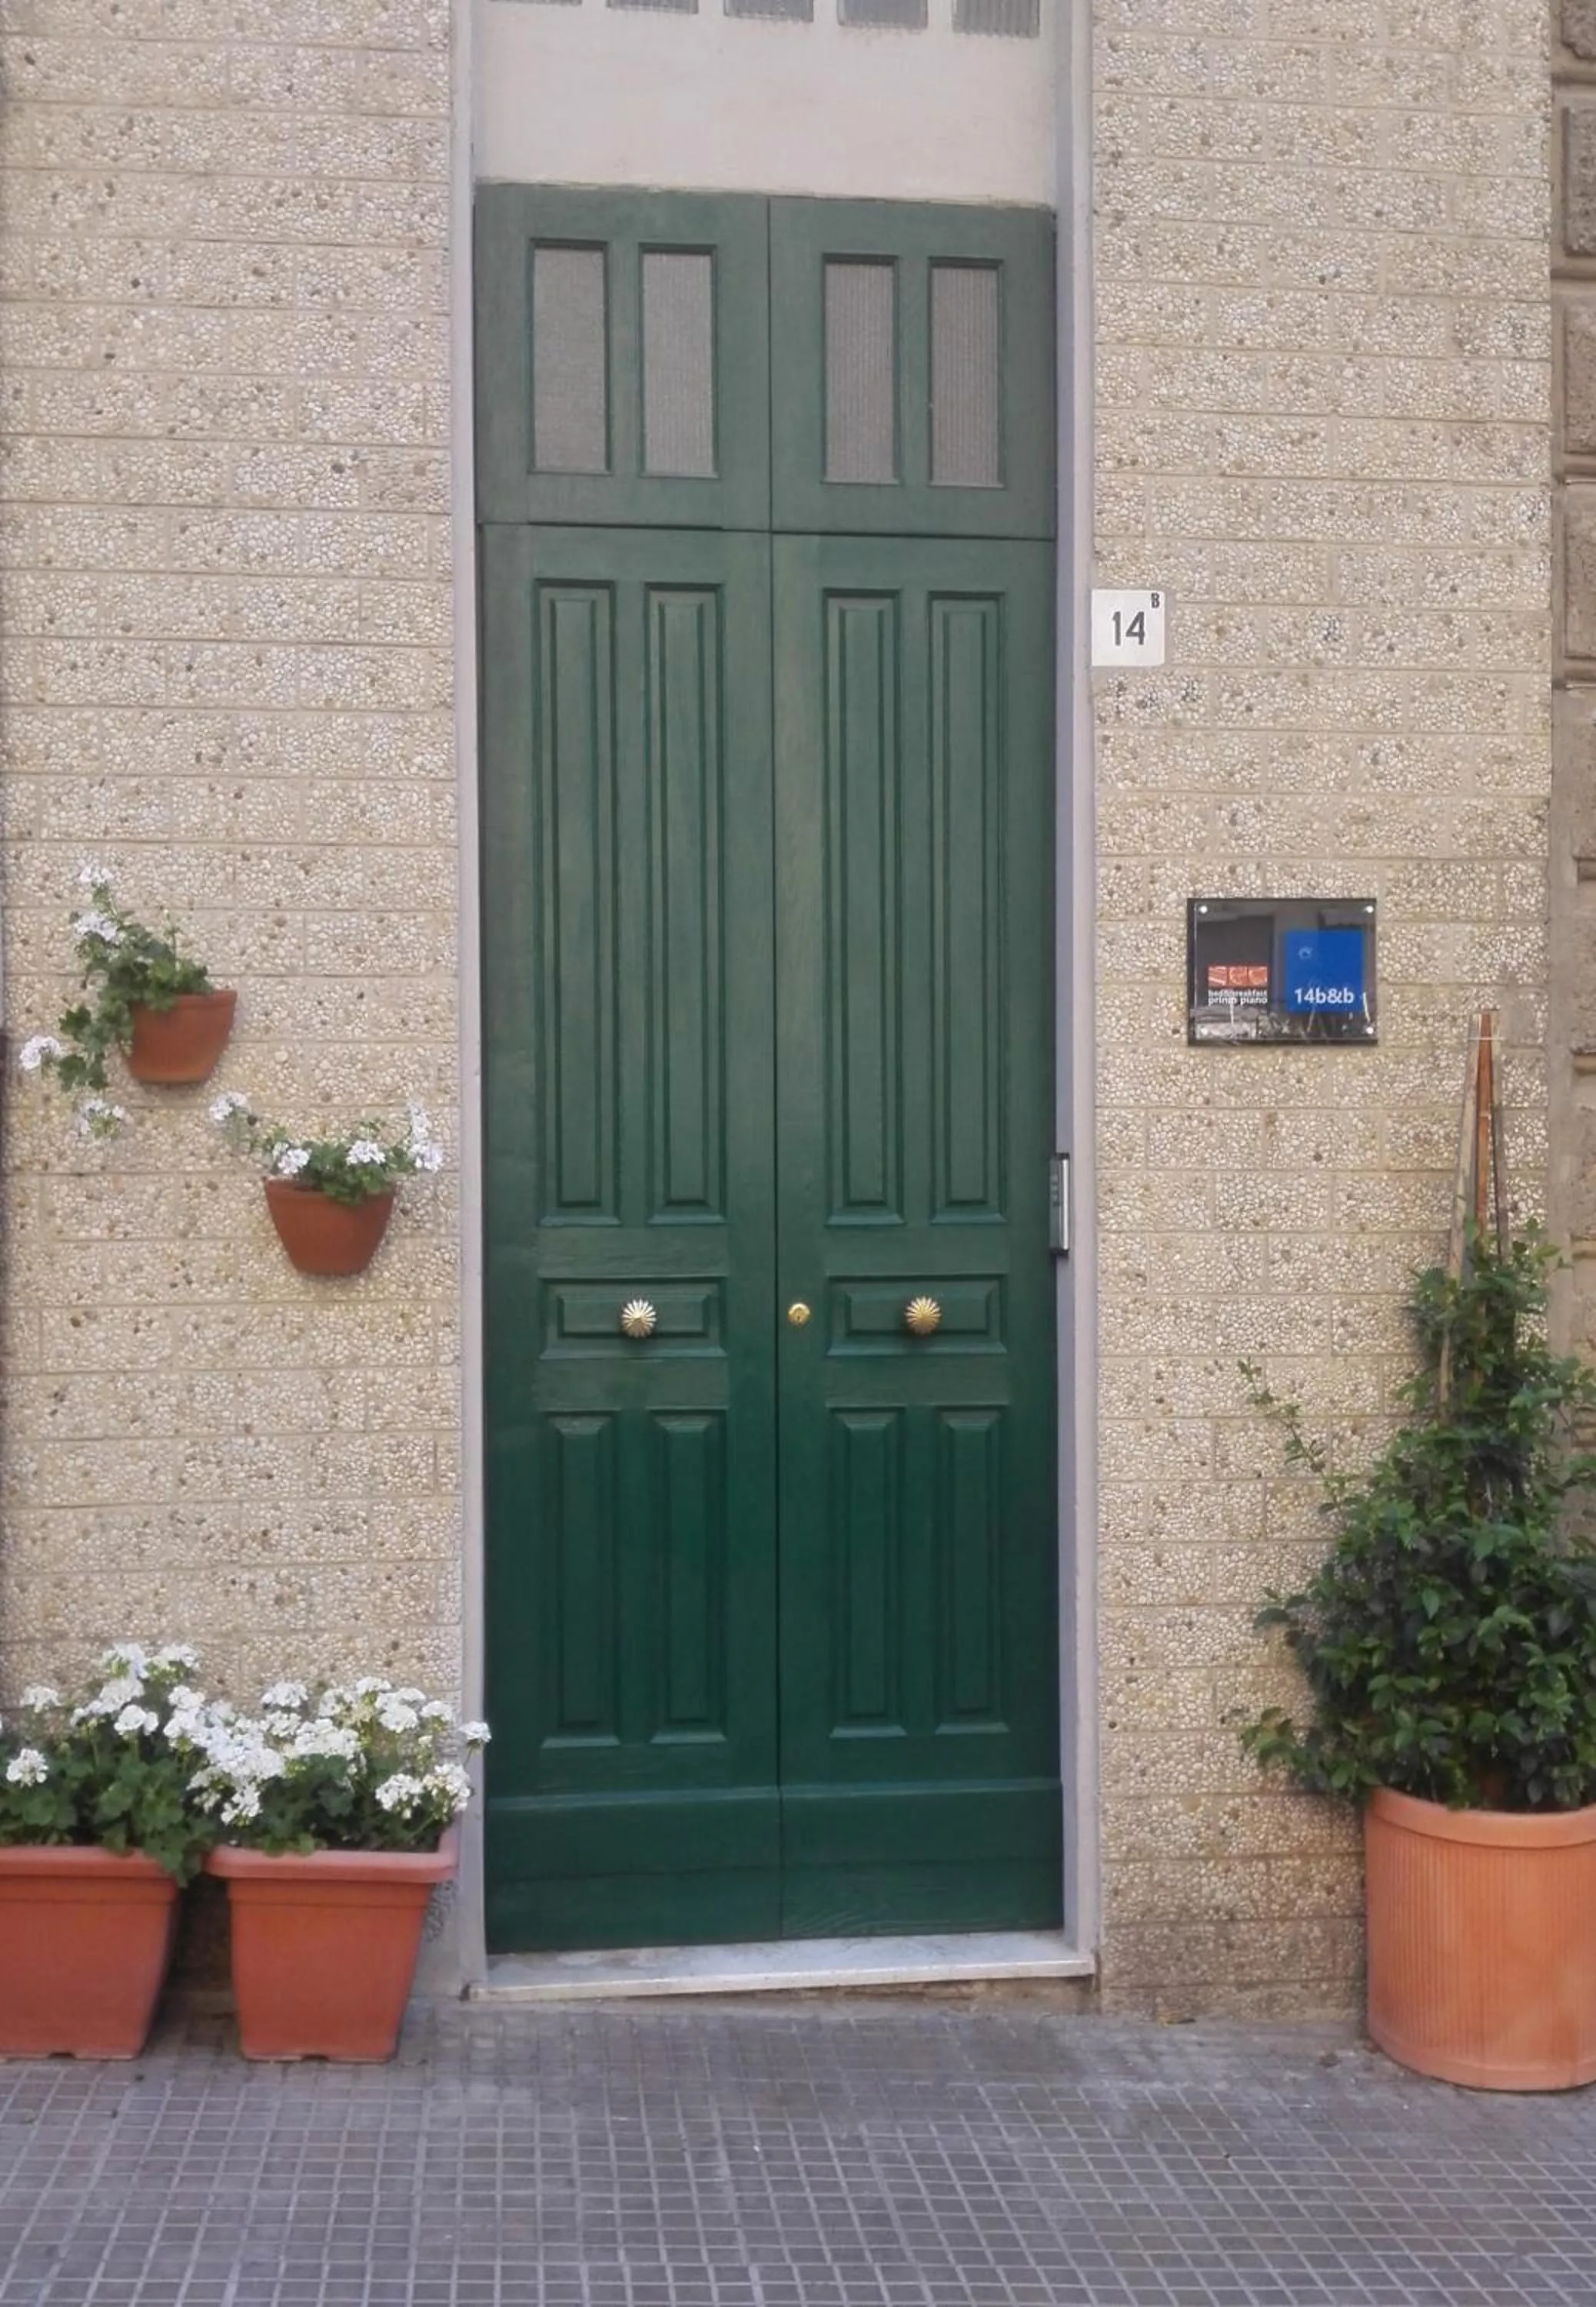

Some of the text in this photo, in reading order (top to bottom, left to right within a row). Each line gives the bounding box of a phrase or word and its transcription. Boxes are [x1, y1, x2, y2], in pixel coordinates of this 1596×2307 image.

[1151, 593, 1159, 608] B
[1112, 611, 1145, 647] 14
[1240, 997, 1268, 1006] piano
[1294, 987, 1354, 1004] 14b&b
